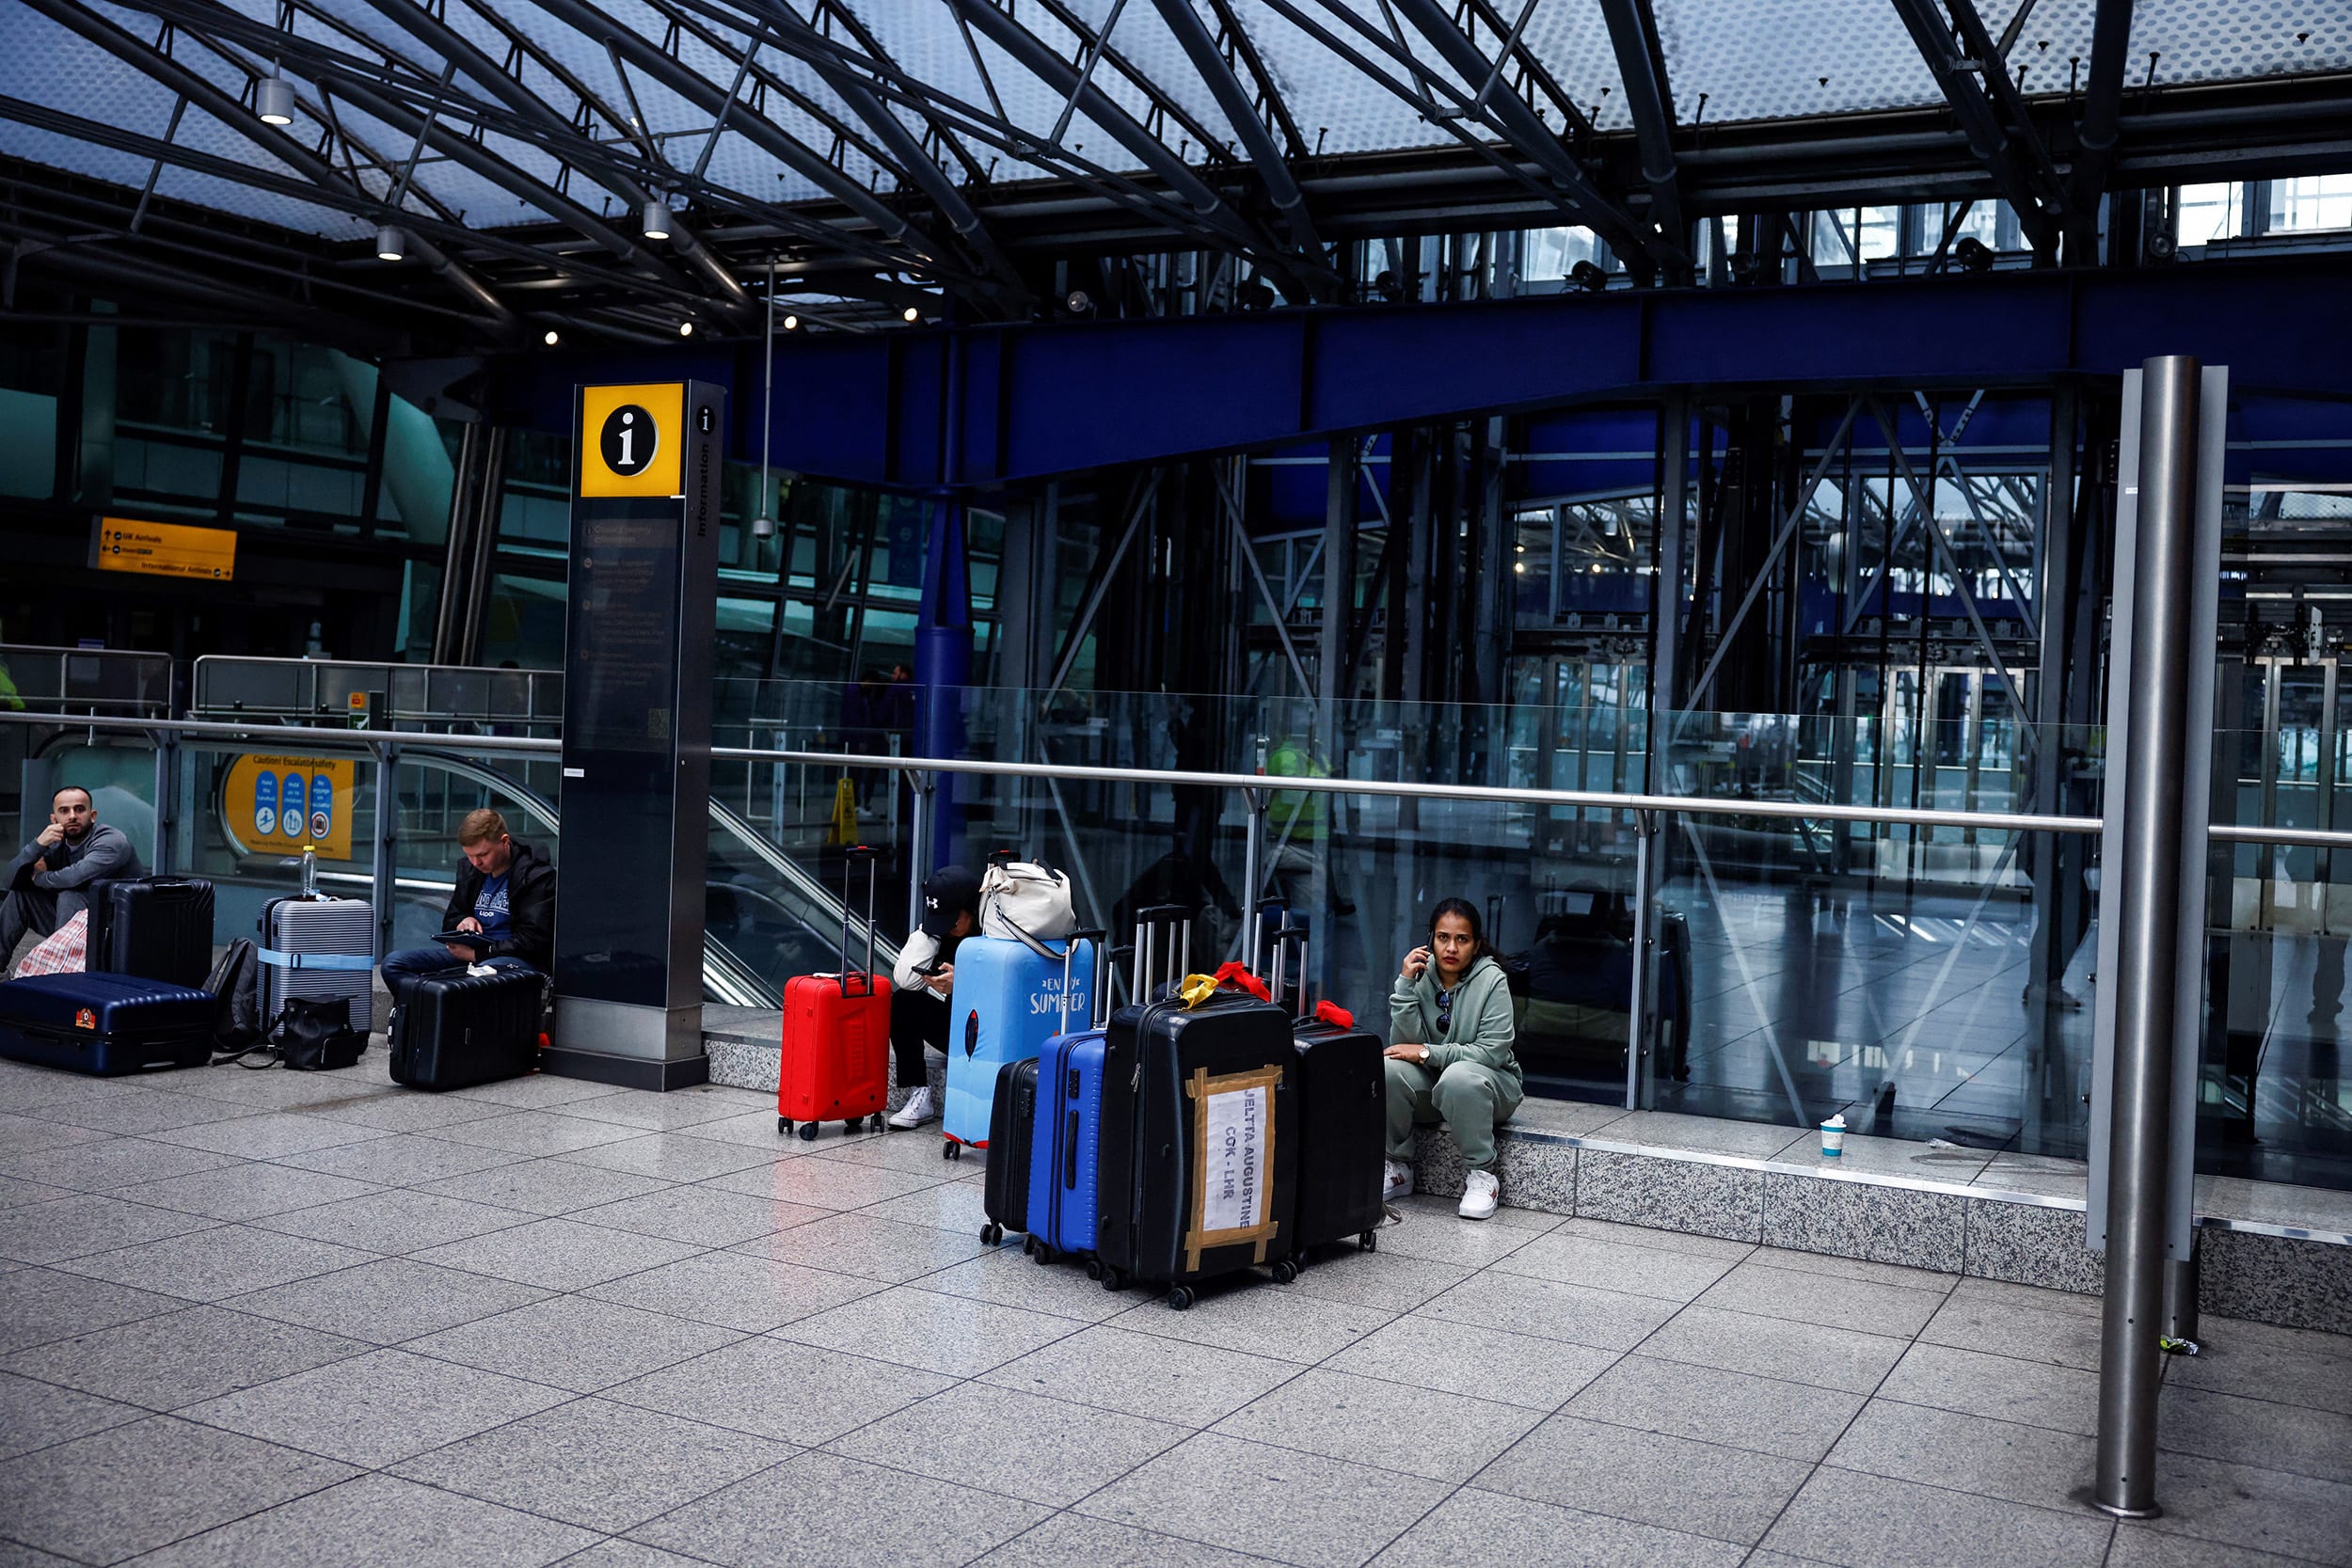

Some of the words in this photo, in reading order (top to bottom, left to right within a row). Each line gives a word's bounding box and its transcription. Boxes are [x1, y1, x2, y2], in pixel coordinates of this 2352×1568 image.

[617, 412, 635, 466] i
[698, 443, 709, 537] Information
[135, 534, 161, 543] Arrivals
[314, 760, 336, 770] safety
[1047, 976, 1076, 990] ENY
[1223, 1169, 1235, 1199] LHR
[1239, 1145, 1255, 1229] AUGUSTINE
